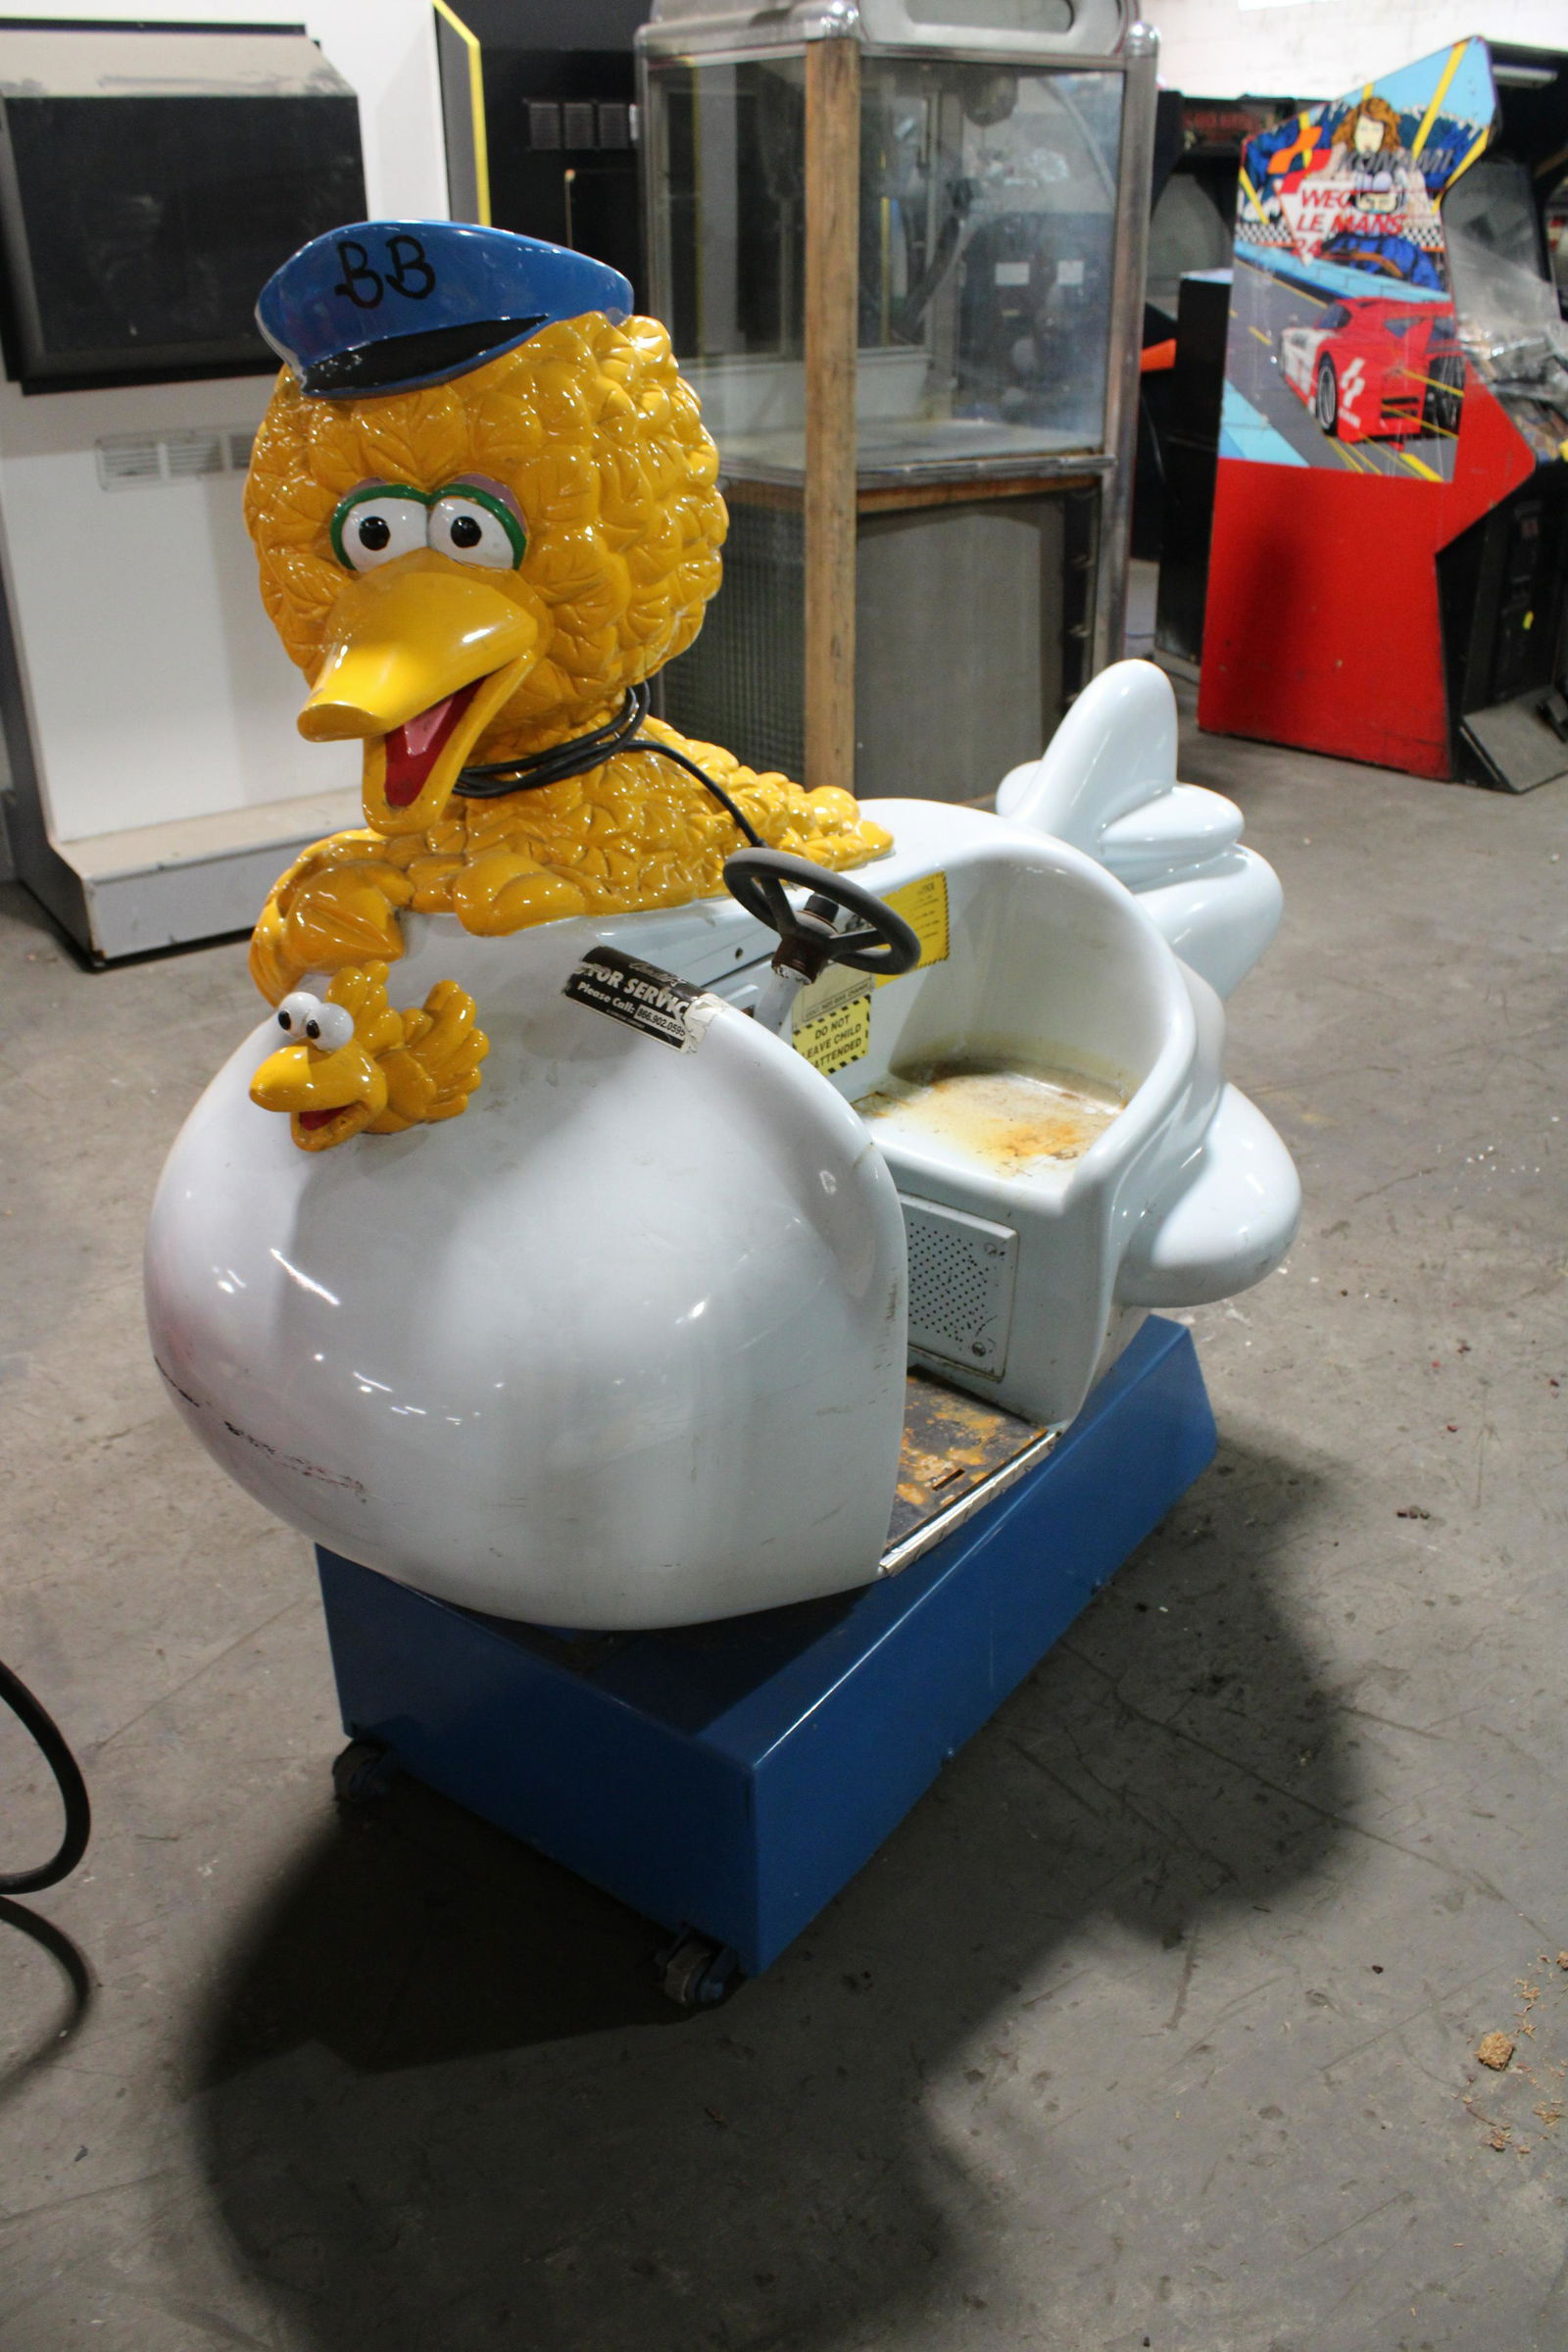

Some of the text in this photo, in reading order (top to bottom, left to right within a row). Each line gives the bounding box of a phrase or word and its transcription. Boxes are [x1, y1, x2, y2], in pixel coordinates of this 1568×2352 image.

[1297, 213, 1408, 236] LE MANS
[577, 981, 612, 1004] Please
[612, 997, 636, 1015] Call:
[623, 977, 690, 1020] SERVIC
[803, 1023, 862, 1058] EAVE CHILD
[814, 1013, 850, 1040] DO NOT
